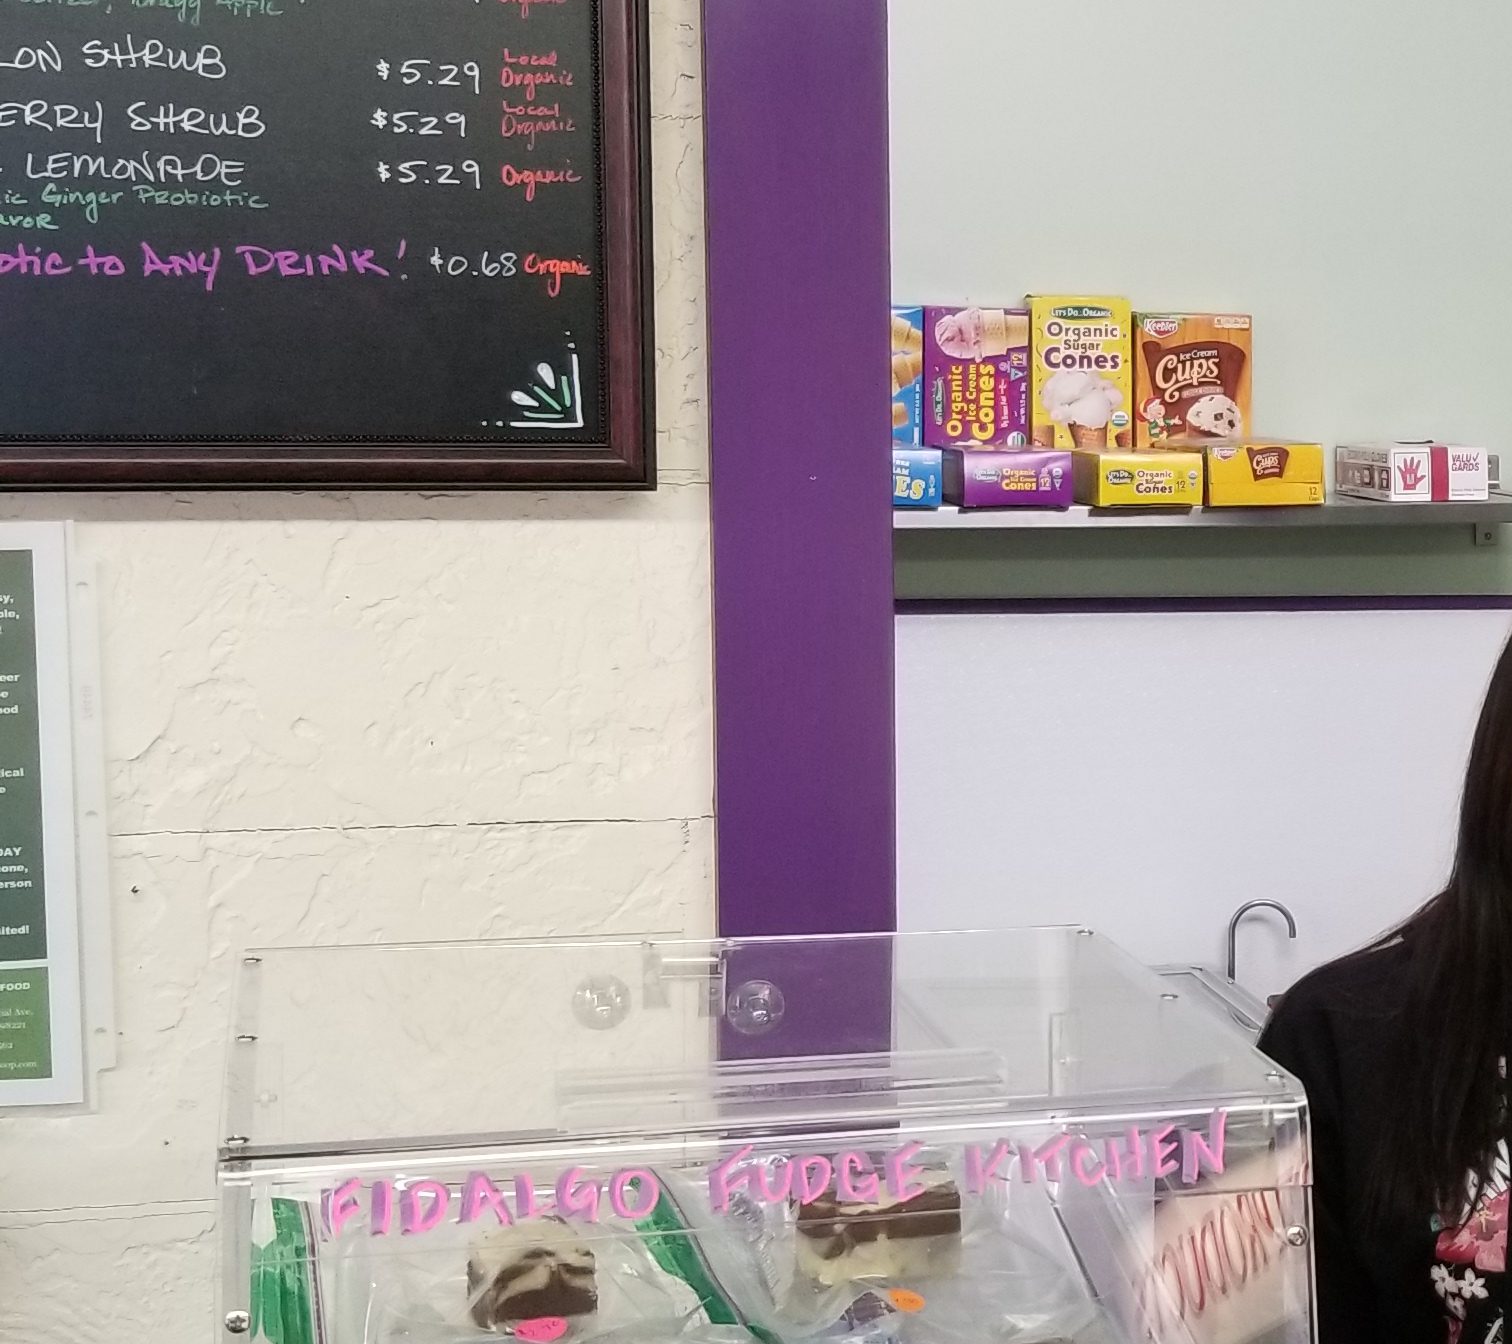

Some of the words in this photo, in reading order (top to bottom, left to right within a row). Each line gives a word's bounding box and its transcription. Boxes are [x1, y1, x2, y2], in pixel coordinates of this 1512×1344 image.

[82, 34, 226, 78] SHRUB
[127, 102, 265, 137] SHRUB
[370, 108, 465, 137] $5.29
[26, 151, 244, 187] LEMONADE
[40, 183, 124, 224] Ginger
[77, 244, 127, 277] to
[1047, 321, 1119, 343] Organic
[1063, 339, 1101, 354] Sugar
[1044, 346, 1120, 370] Cones
[1155, 352, 1221, 391] Cups
[965, 364, 977, 400] Cream
[946, 364, 967, 437] Organic
[965, 403, 977, 421] Ice
[971, 363, 996, 440] Cones
[1001, 481, 1037, 491] Cones
[1136, 470, 1173, 481] Organic
[321, 1166, 662, 1241] FIDALGO
[707, 1145, 928, 1215] FUDGE
[963, 1108, 1228, 1195] KITCHEN
